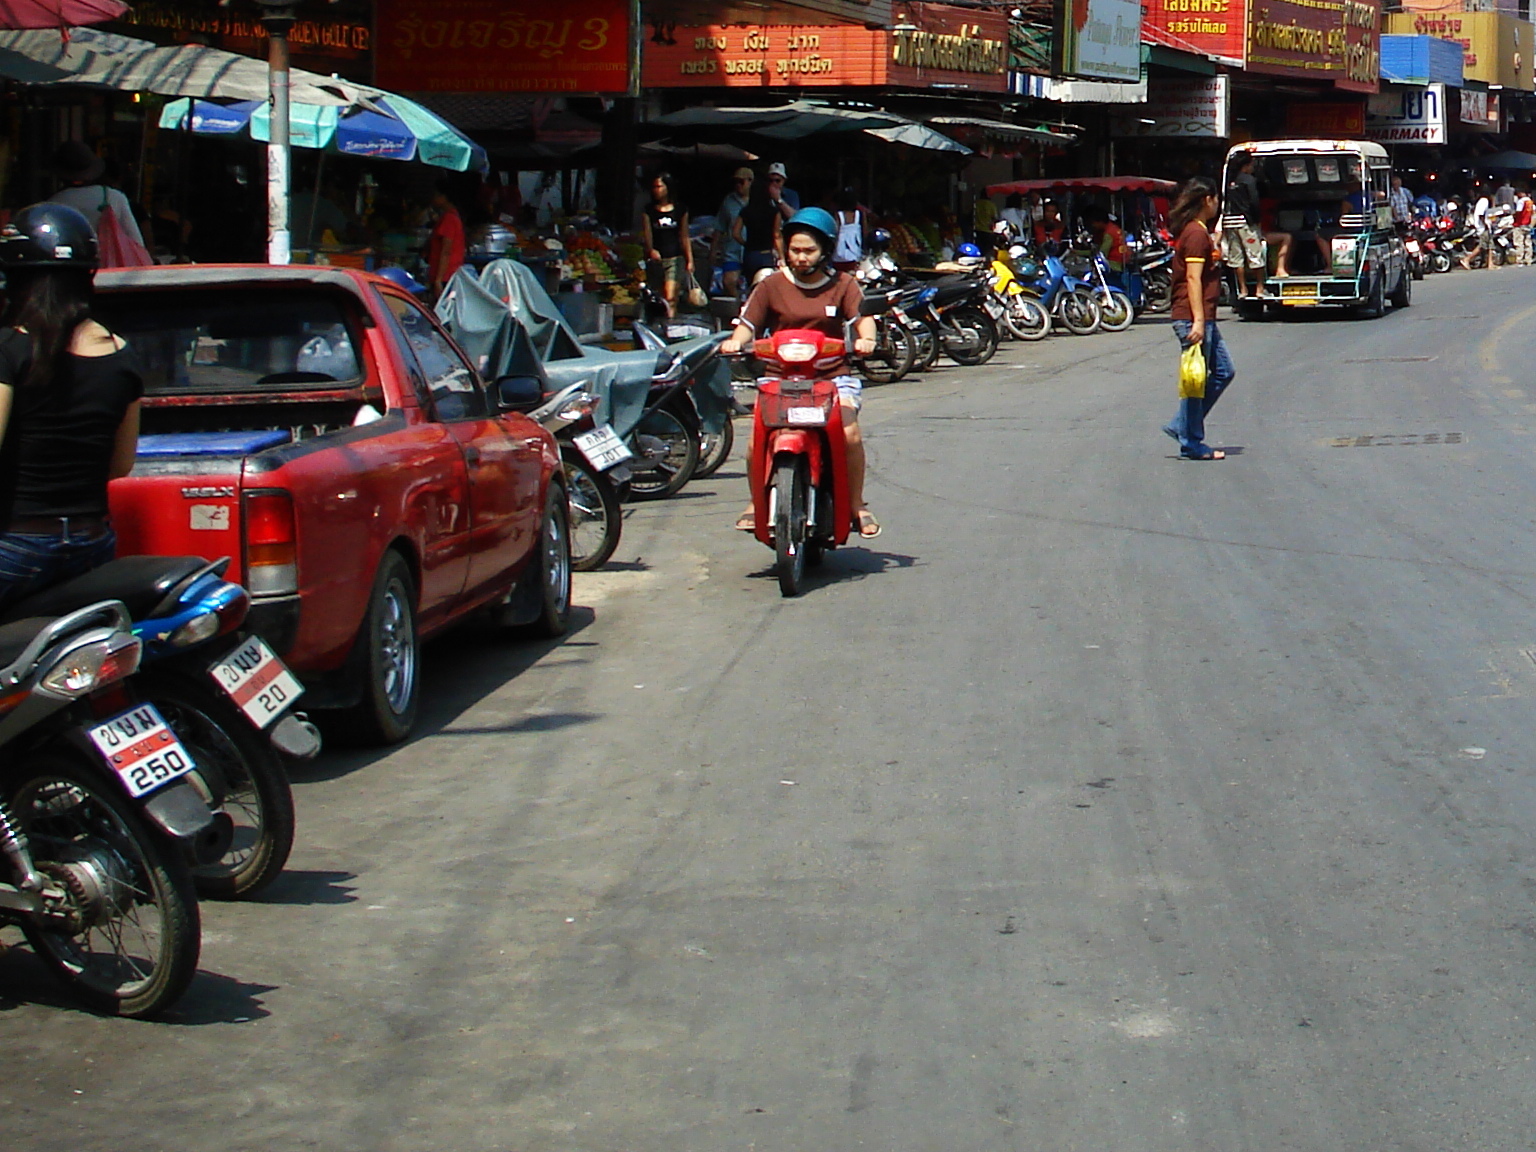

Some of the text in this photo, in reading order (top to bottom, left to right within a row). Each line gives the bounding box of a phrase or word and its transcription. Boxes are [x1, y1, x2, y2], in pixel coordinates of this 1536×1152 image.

[578, 17, 610, 52] 3
[258, 683, 287, 713] 20
[131, 750, 185, 791] 250
